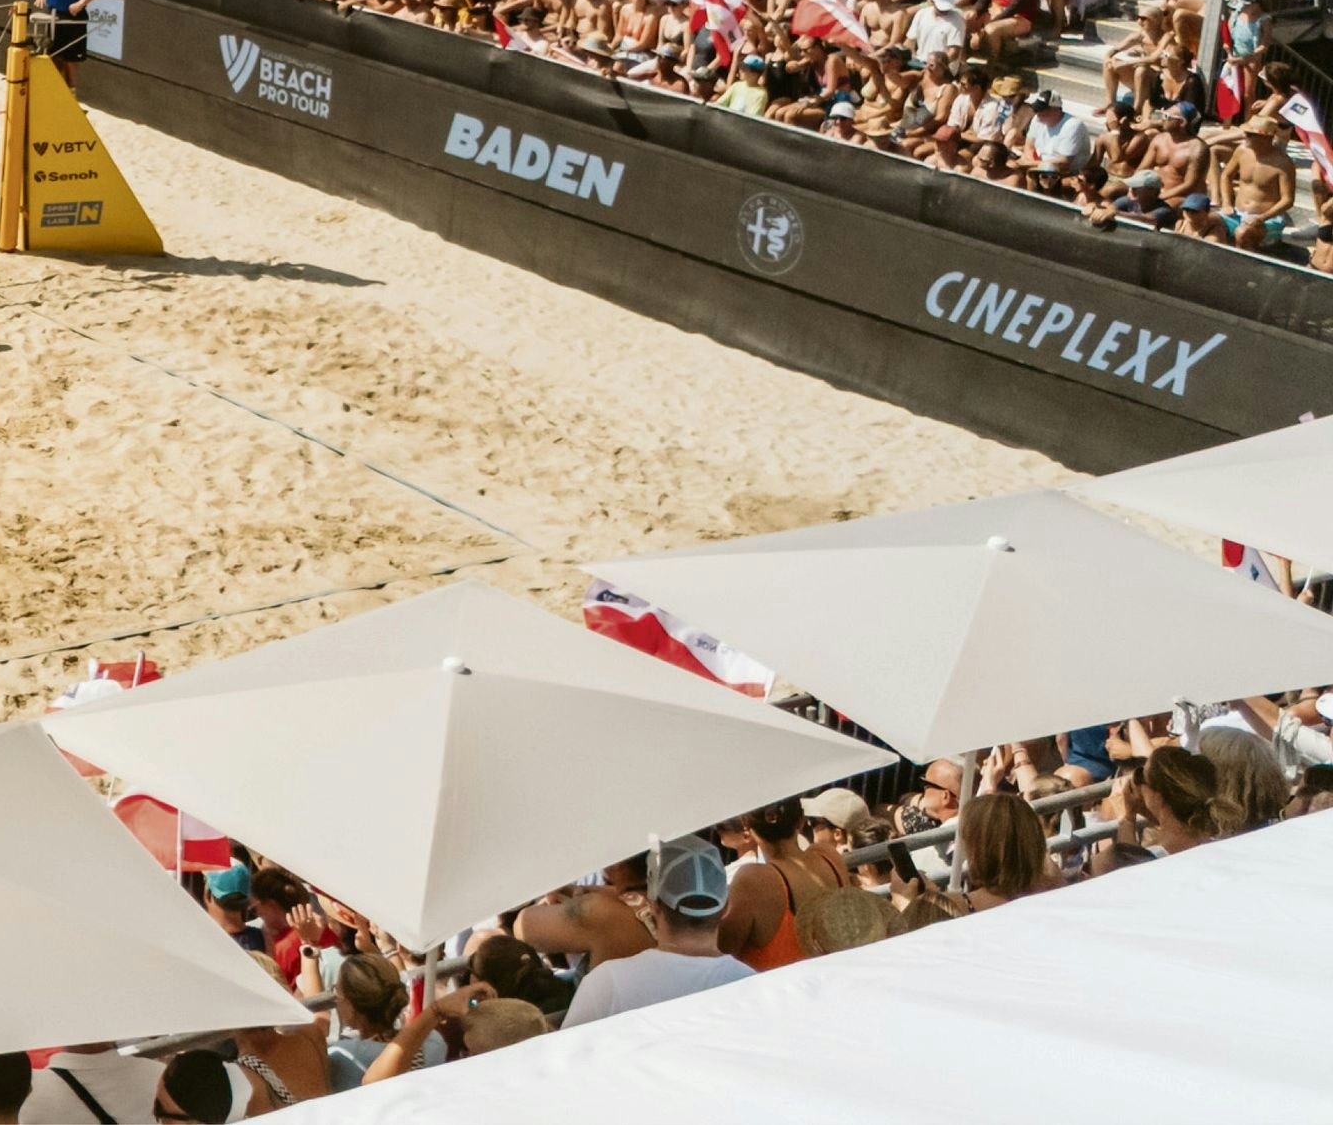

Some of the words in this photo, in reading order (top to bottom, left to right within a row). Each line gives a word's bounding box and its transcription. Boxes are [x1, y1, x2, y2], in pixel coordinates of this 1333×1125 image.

[259, 58, 332, 101] BEACH
[258, 83, 288, 105] PRO
[290, 92, 330, 119] TOUR
[52, 141, 97, 154] VBTV
[444, 113, 625, 207] BADEN
[48, 170, 99, 182] Senoh
[926, 271, 1227, 396] CINEPLEXX
